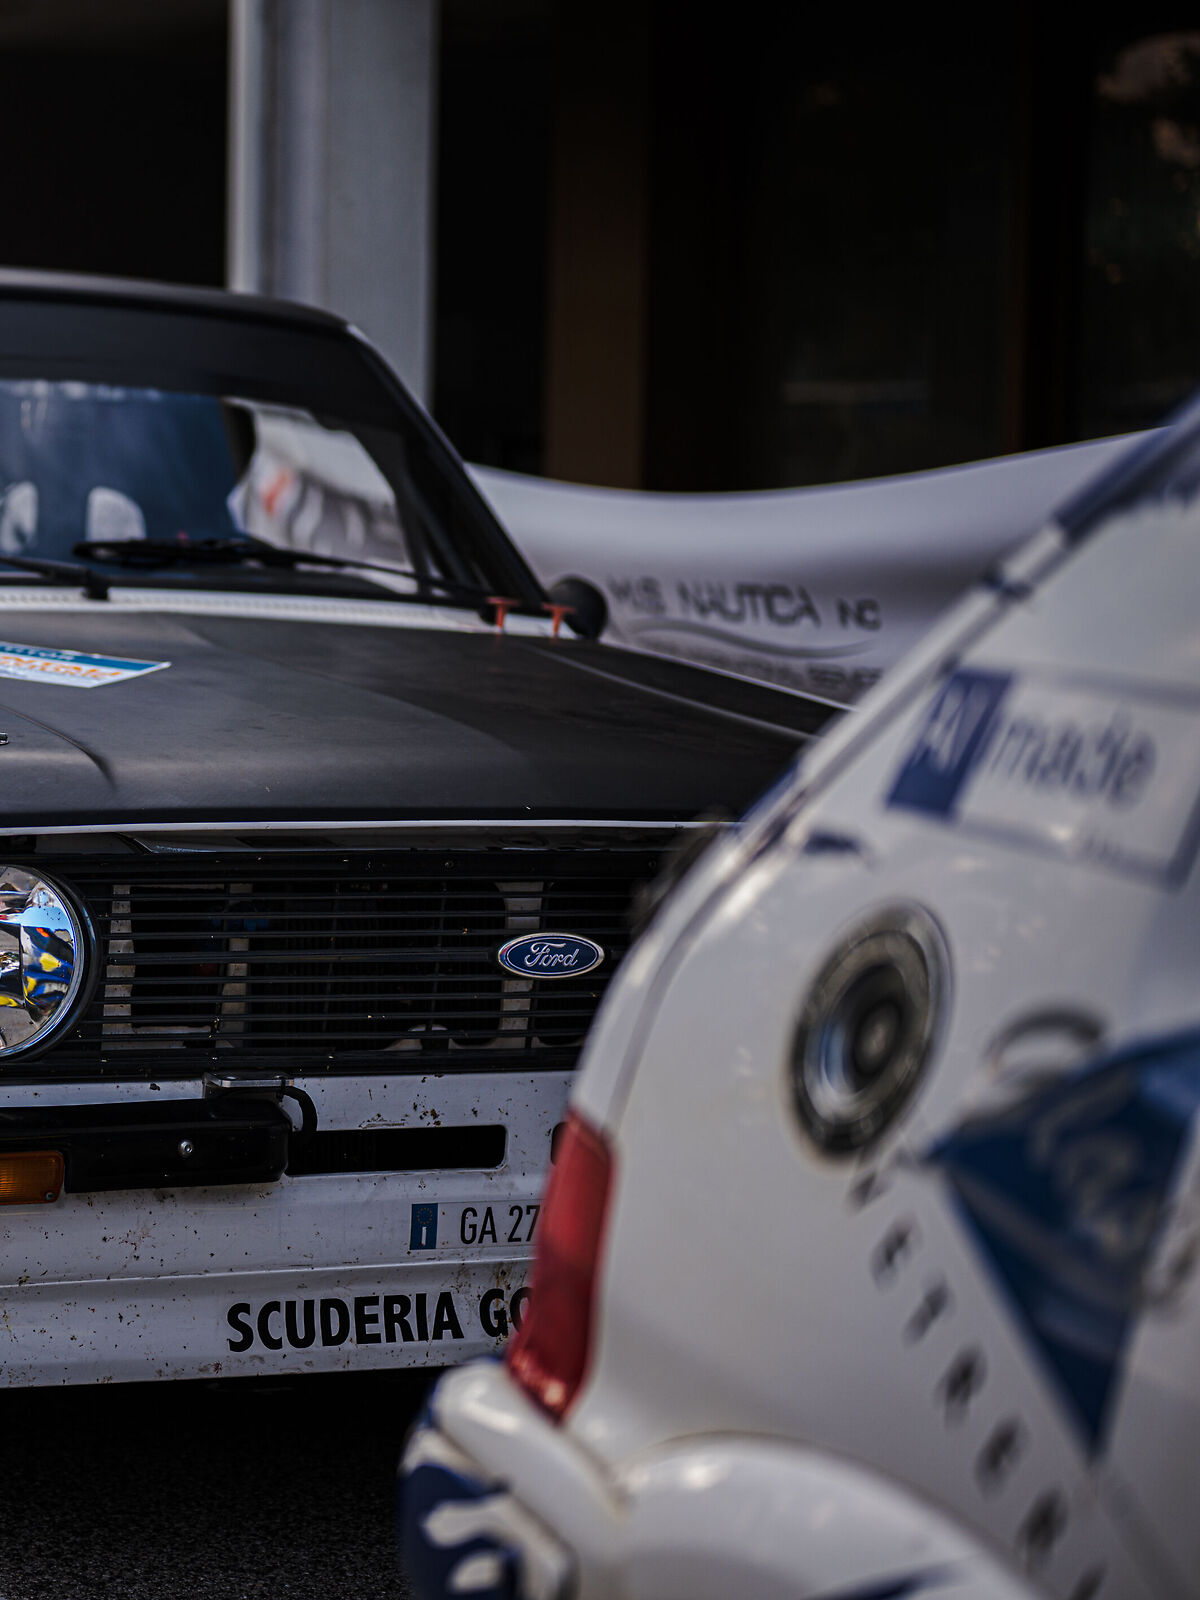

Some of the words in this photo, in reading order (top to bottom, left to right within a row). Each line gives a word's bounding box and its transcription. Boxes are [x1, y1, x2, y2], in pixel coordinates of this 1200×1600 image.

[524, 941, 580, 967] Ford
[460, 1206, 497, 1244] GA
[226, 1291, 465, 1353] SCUDERIA
